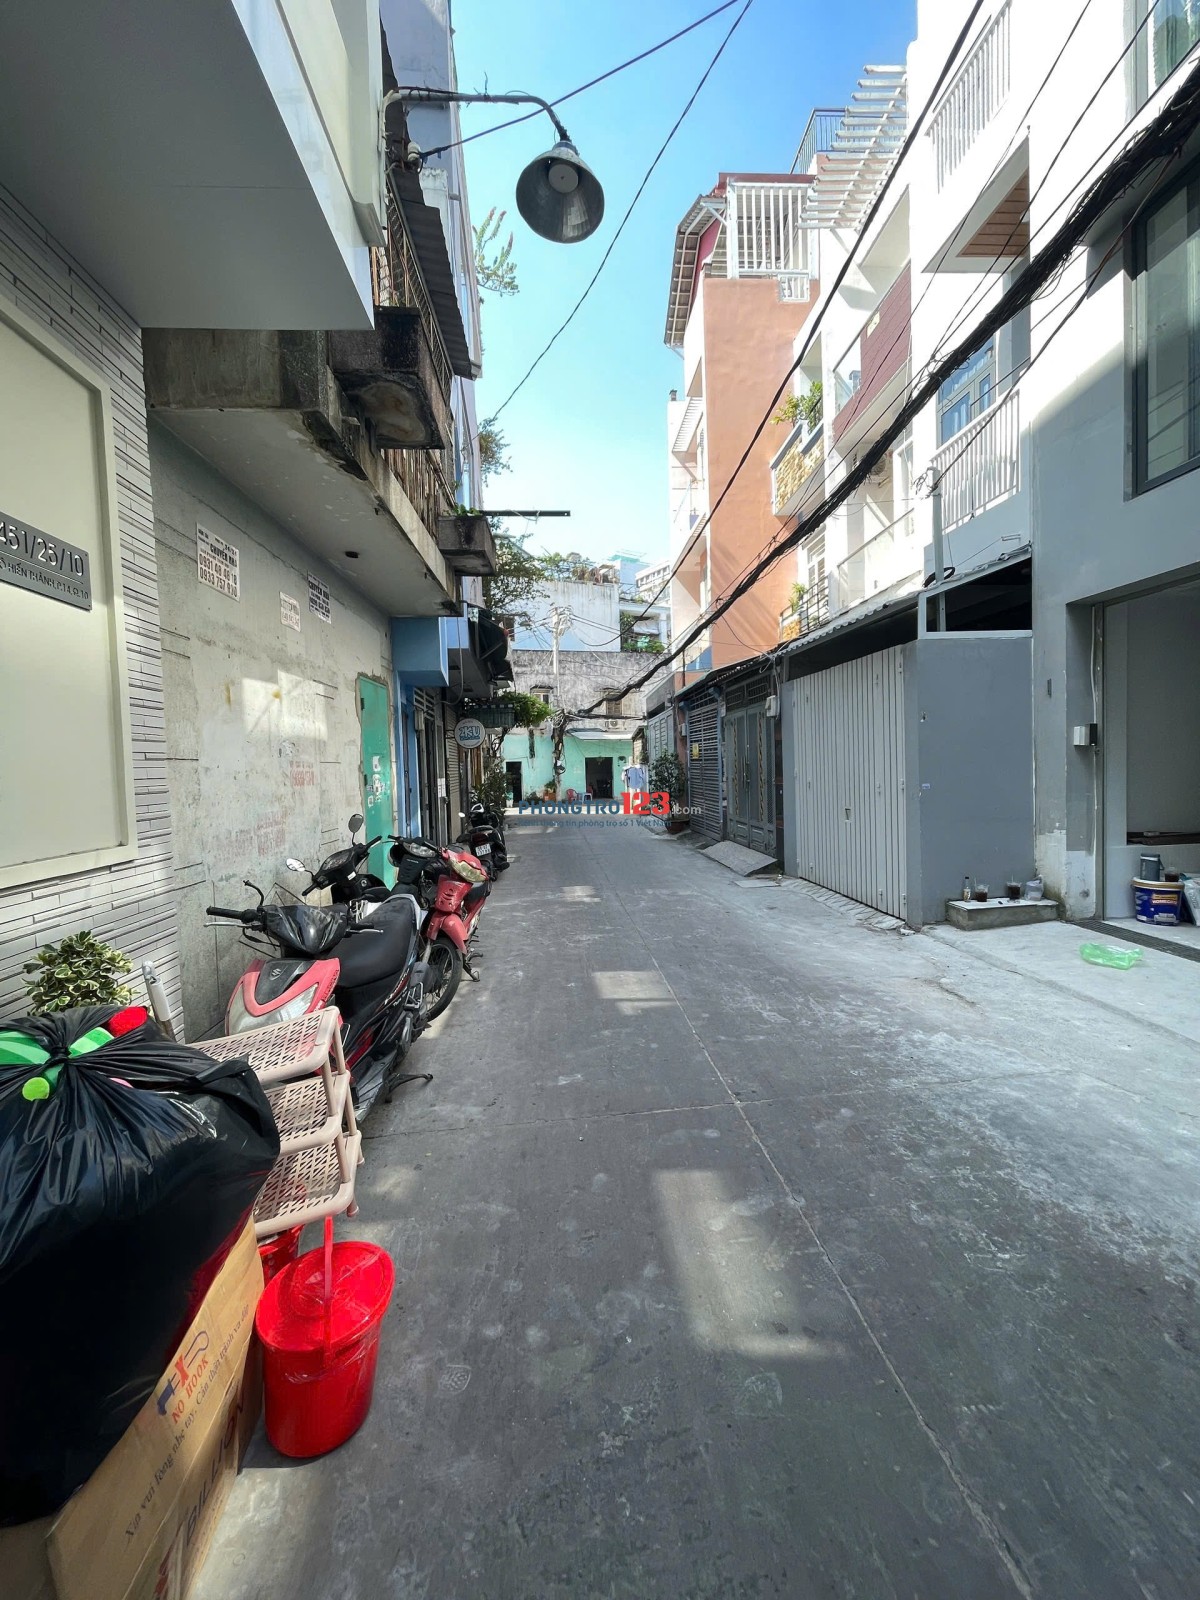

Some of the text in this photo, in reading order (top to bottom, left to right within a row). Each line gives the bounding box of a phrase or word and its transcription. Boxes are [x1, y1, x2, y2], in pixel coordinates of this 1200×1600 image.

[199, 566, 215, 586] 0933
[171, 1356, 209, 1424] NO HOOK
